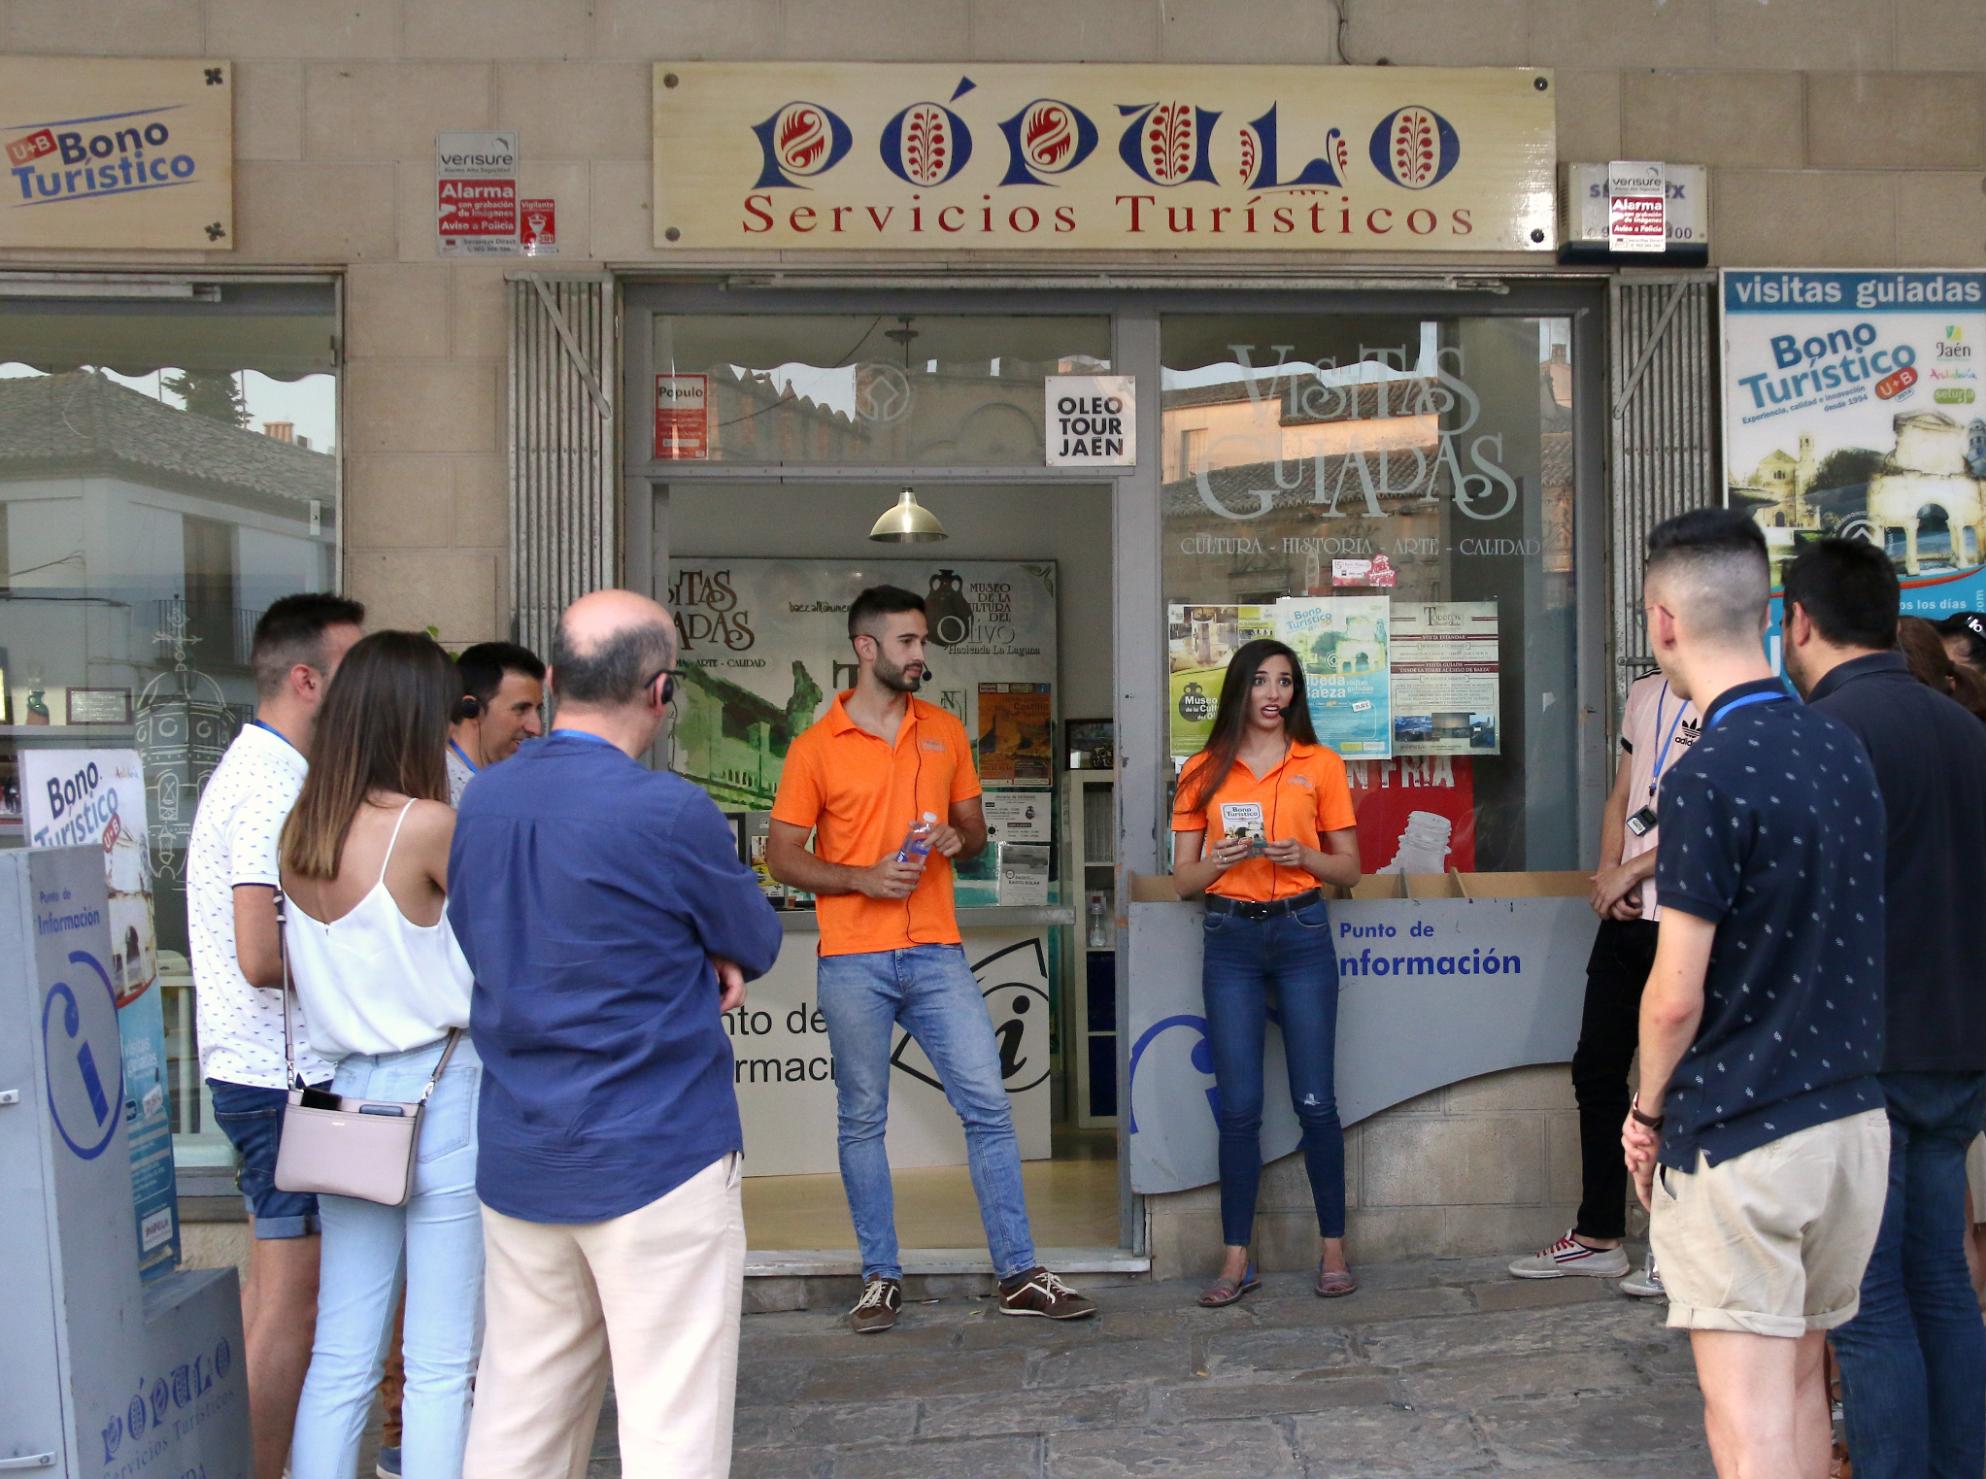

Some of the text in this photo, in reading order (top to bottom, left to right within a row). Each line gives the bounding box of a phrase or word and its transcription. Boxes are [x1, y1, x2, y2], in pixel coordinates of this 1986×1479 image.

[57, 123, 168, 165] Bono
[441, 154, 513, 165] verisure
[11, 148, 195, 199] Turístico
[441, 182, 513, 198] Alarma
[1612, 177, 1662, 187] verisure
[1612, 199, 1663, 211] Alarma
[742, 194, 1473, 235] Servicios Turísticos
[442, 221, 469, 230] Aviso
[1613, 225, 1633, 233] Aviso
[1736, 275, 1981, 309] visitas guiadas
[1770, 322, 1877, 370] Bono
[1936, 341, 1971, 357] Jaén
[1738, 345, 1917, 409] Turístico
[1057, 397, 1123, 415] OLEO
[1059, 417, 1122, 435] TOUR
[1181, 537, 1262, 555] CULTURA
[1282, 537, 1372, 555] HISTORIA
[1392, 539, 1439, 555] ARTE
[1460, 538, 1541, 556] CALIDAD
[970, 583, 1011, 592] MUSEO
[978, 593, 1011, 602] DE LA
[1917, 600, 1936, 609] los
[989, 613, 1011, 622] DEL
[1294, 607, 1321, 620] Bono
[673, 611, 755, 651] ADAS
[727, 659, 766, 667] CALIDAD
[1307, 675, 1345, 686] beda
[1185, 696, 1218, 705] Museo
[1675, 736, 1693, 747] adid
[47, 761, 99, 819] Bono
[37, 906, 99, 936] Información
[1340, 921, 1434, 938] Punto de
[1340, 947, 1521, 976] nformación
[720, 1002, 828, 1035] nto de
